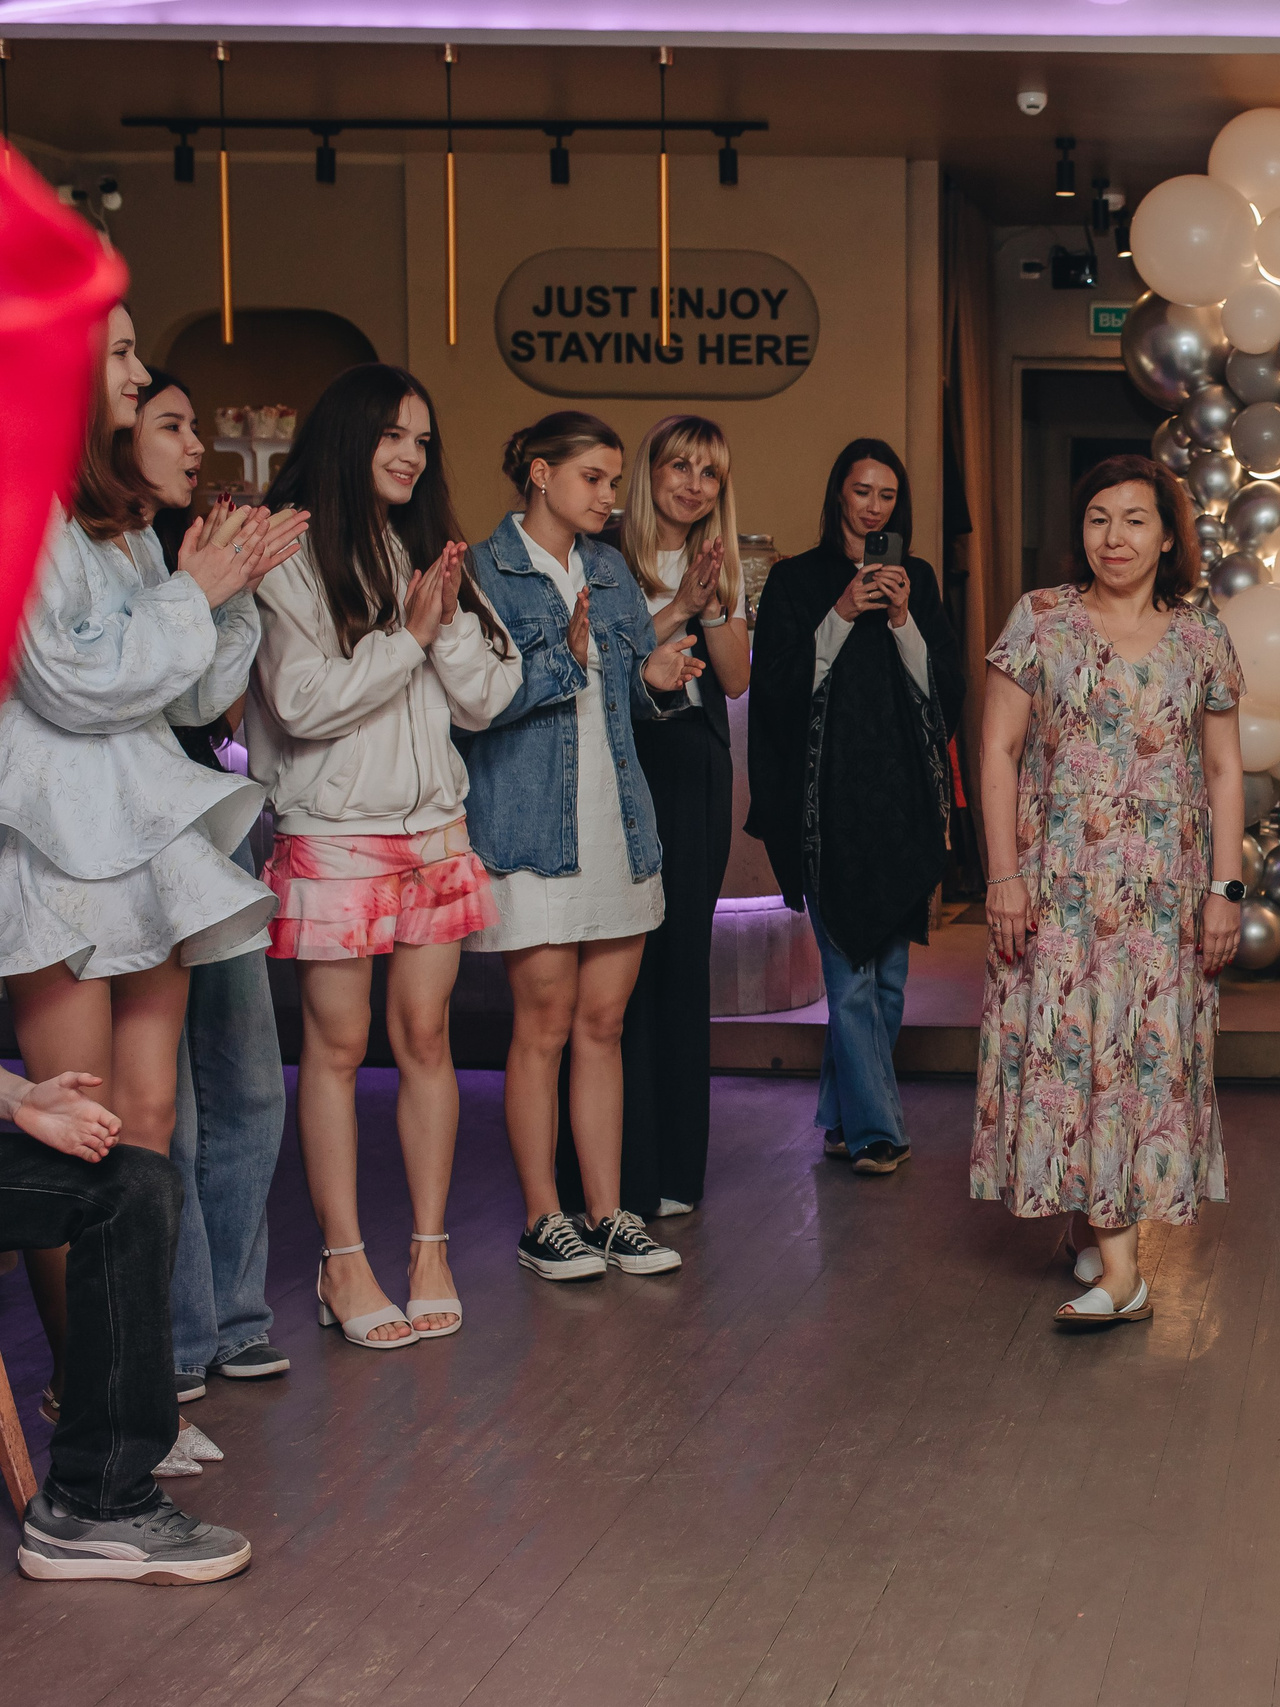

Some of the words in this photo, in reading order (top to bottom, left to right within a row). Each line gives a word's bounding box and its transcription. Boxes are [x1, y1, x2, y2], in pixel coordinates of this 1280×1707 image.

[532, 285, 637, 319] JUST
[650, 286, 789, 320] ENJOY
[510, 330, 684, 364] STAYING
[698, 333, 810, 366] HERE
